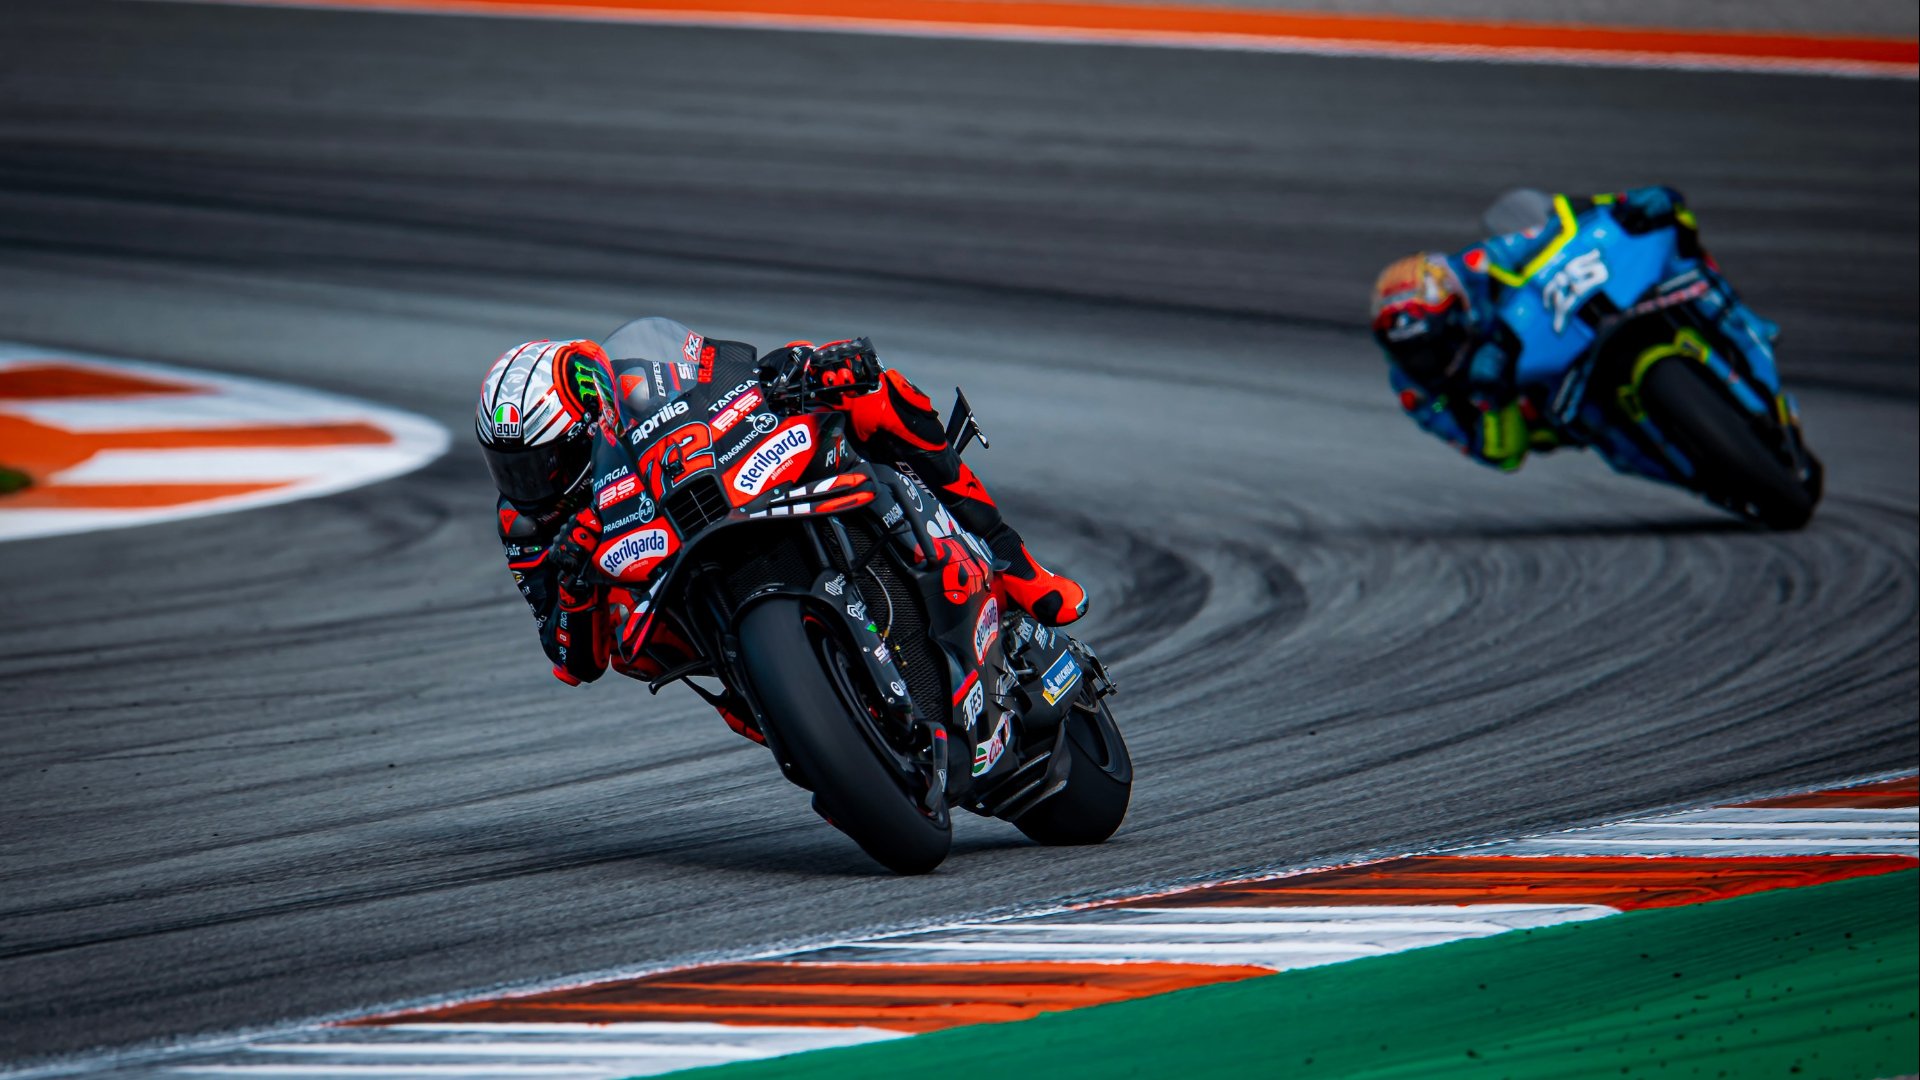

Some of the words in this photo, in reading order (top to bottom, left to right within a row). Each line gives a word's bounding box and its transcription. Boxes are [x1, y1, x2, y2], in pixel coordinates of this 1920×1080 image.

[708, 379, 759, 412] TARGA
[712, 391, 759, 430] BS
[496, 422, 519, 436] agv
[631, 400, 689, 445] aprilia
[637, 421, 717, 503] 72
[718, 429, 760, 464] PRAGMATIC
[740, 430, 807, 490] sterilgarda
[594, 465, 629, 491] TARGA
[599, 477, 636, 505] BS
[603, 511, 640, 534] PRAGMATIC
[604, 531, 665, 573] sterilgarda
